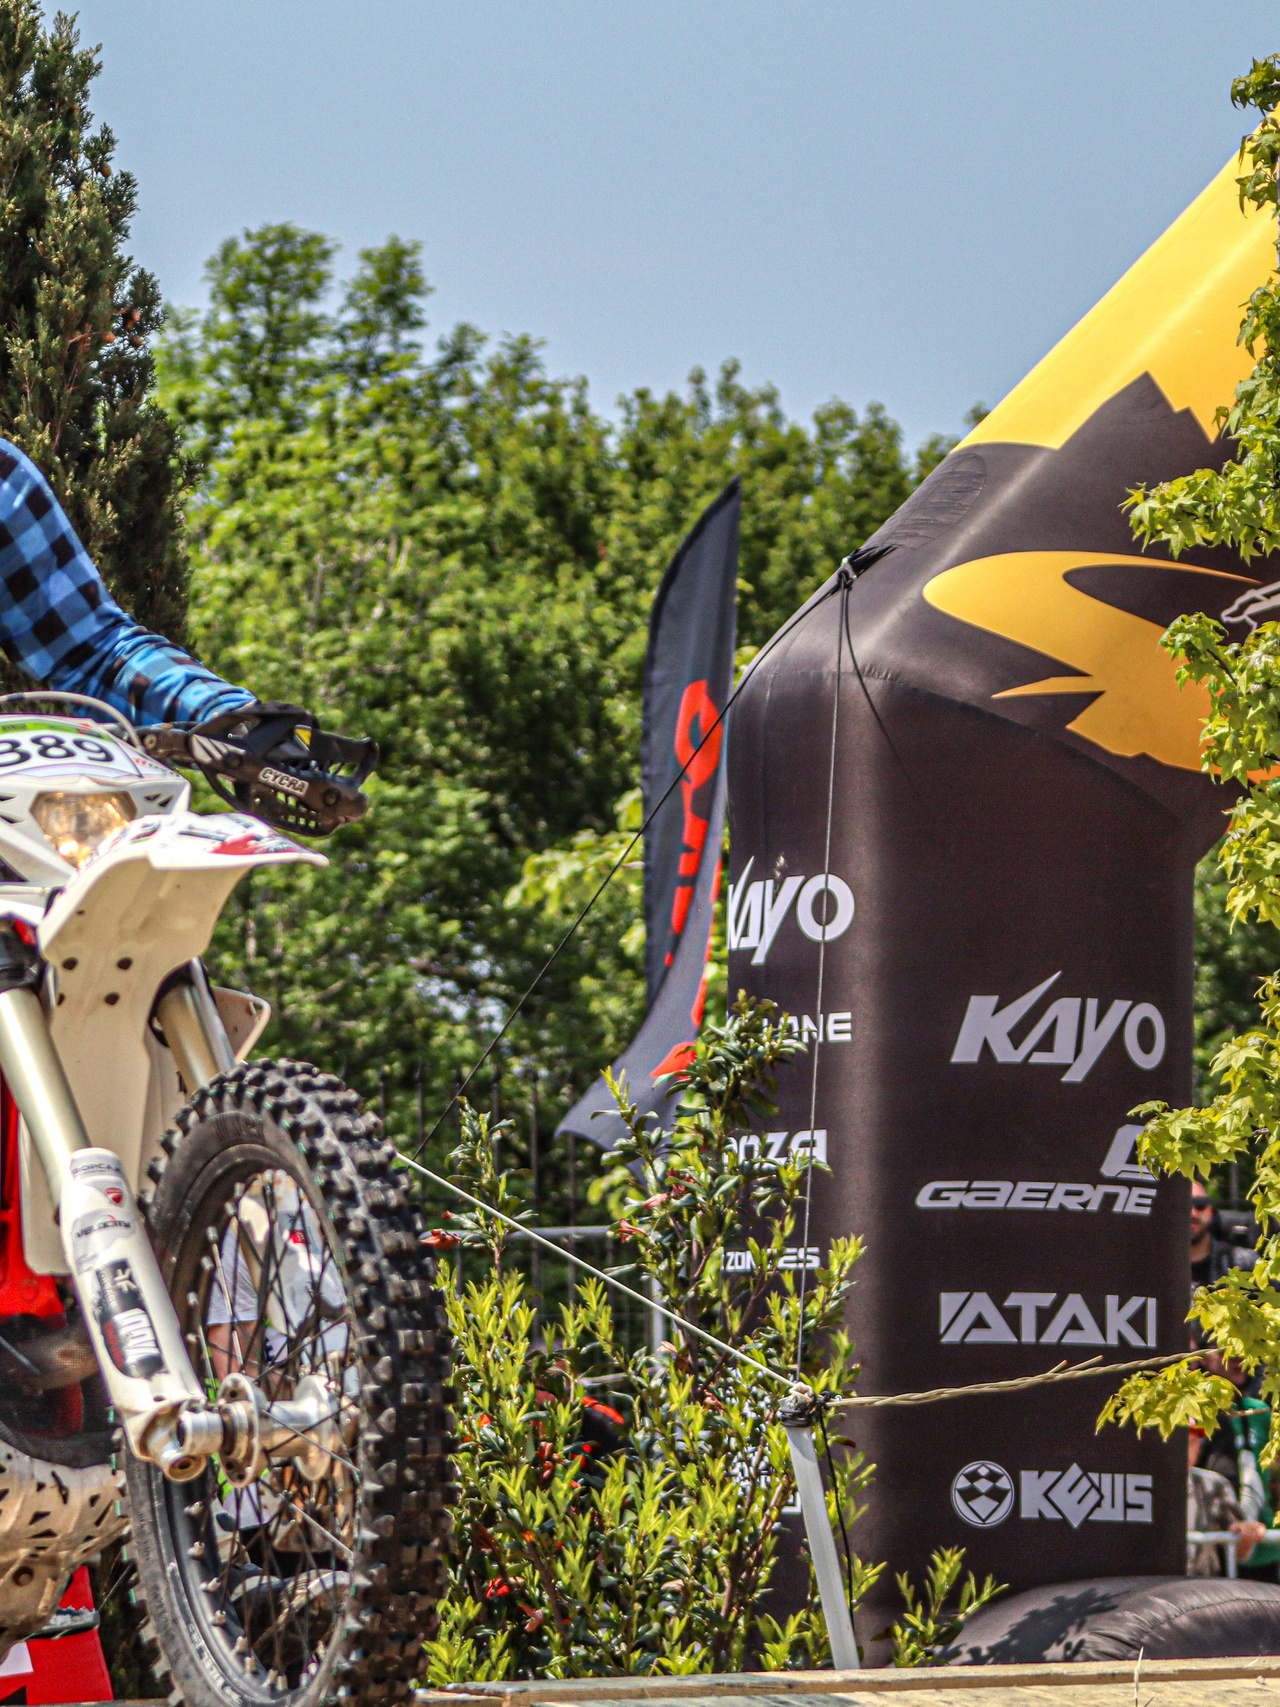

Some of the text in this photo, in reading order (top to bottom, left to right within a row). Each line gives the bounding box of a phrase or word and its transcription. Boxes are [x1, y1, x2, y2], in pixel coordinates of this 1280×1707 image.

[258, 767, 310, 797] CYCRA
[950, 969, 1167, 1083] KAYO
[939, 1291, 1157, 1348] ATAKI
